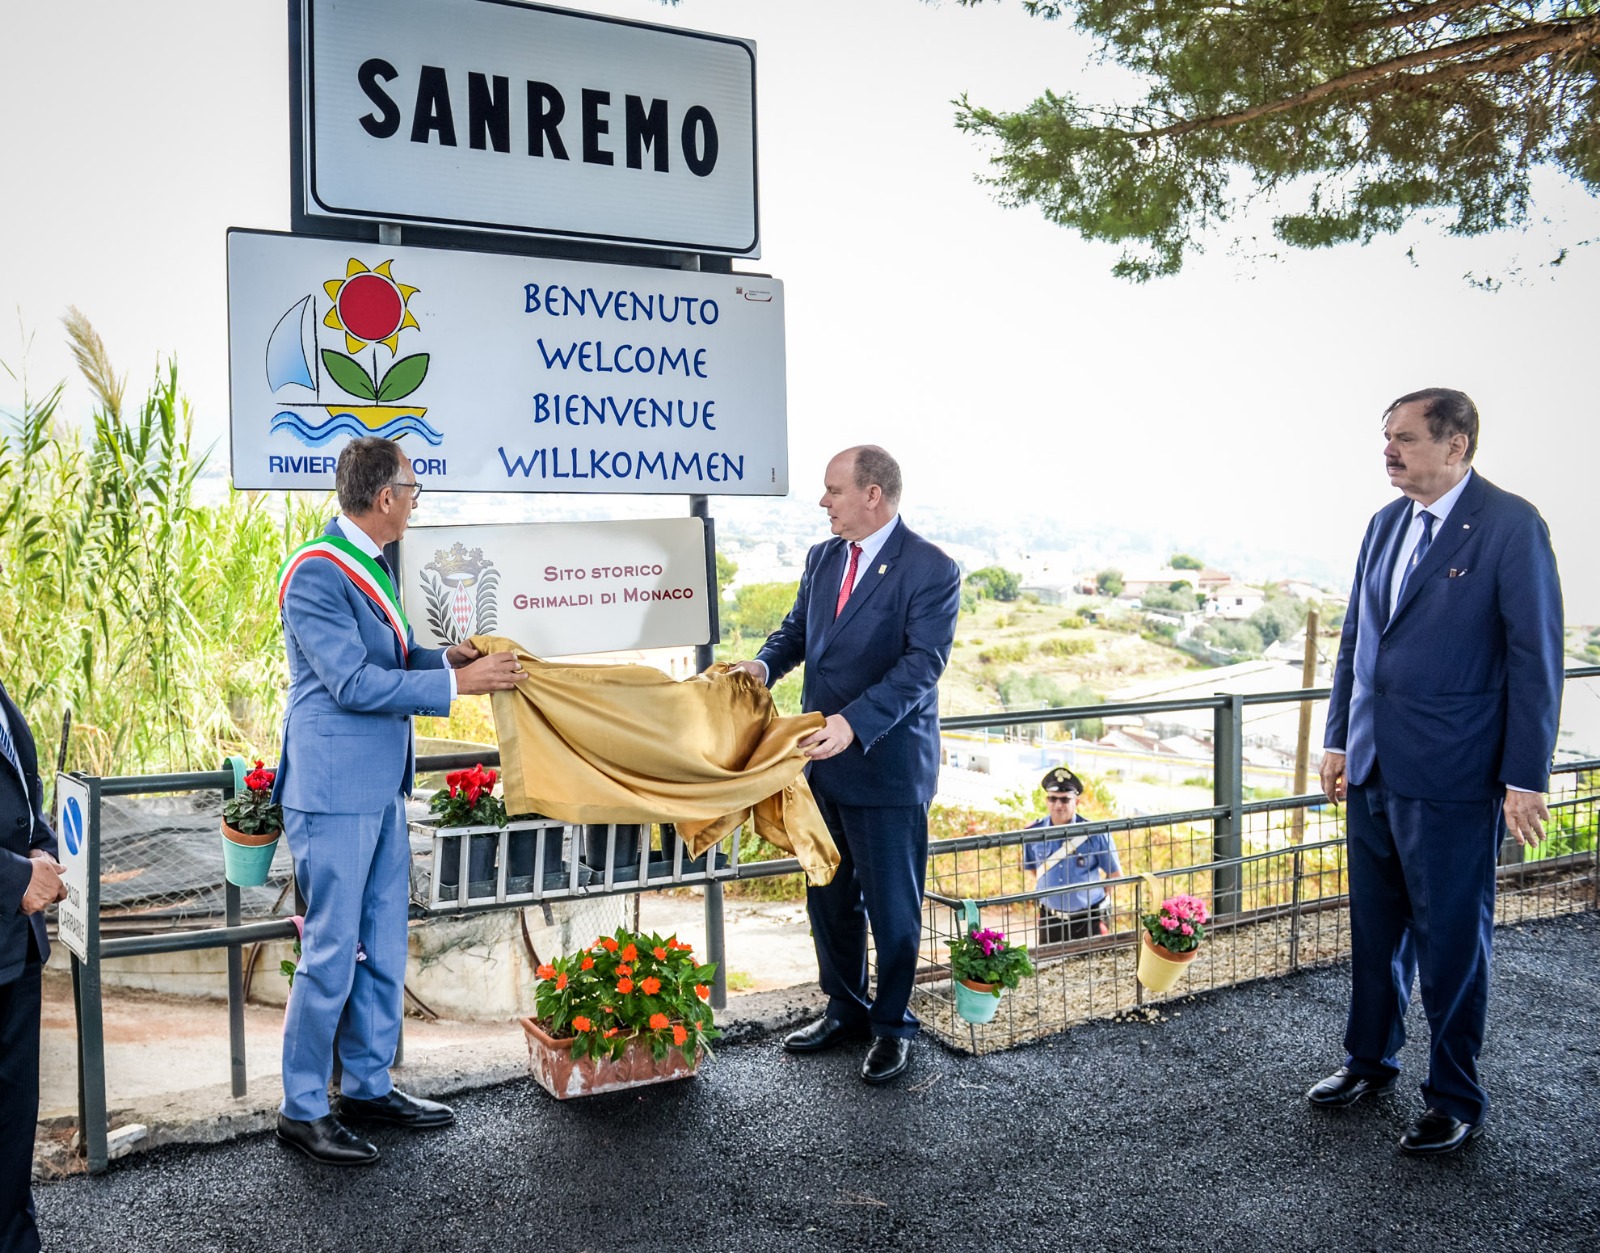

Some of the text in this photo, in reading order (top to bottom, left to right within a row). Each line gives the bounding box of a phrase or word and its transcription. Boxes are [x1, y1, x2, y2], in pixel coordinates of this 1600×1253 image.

[357, 58, 719, 177] SANREMO
[523, 283, 719, 326] BENVENUTO
[536, 338, 708, 379] WELCOME
[532, 392, 717, 431] BIENVENUE
[269, 455, 337, 474] RIVIER
[497, 446, 744, 483] WILLKOMMEN
[61, 907, 84, 943] CARRABILE
